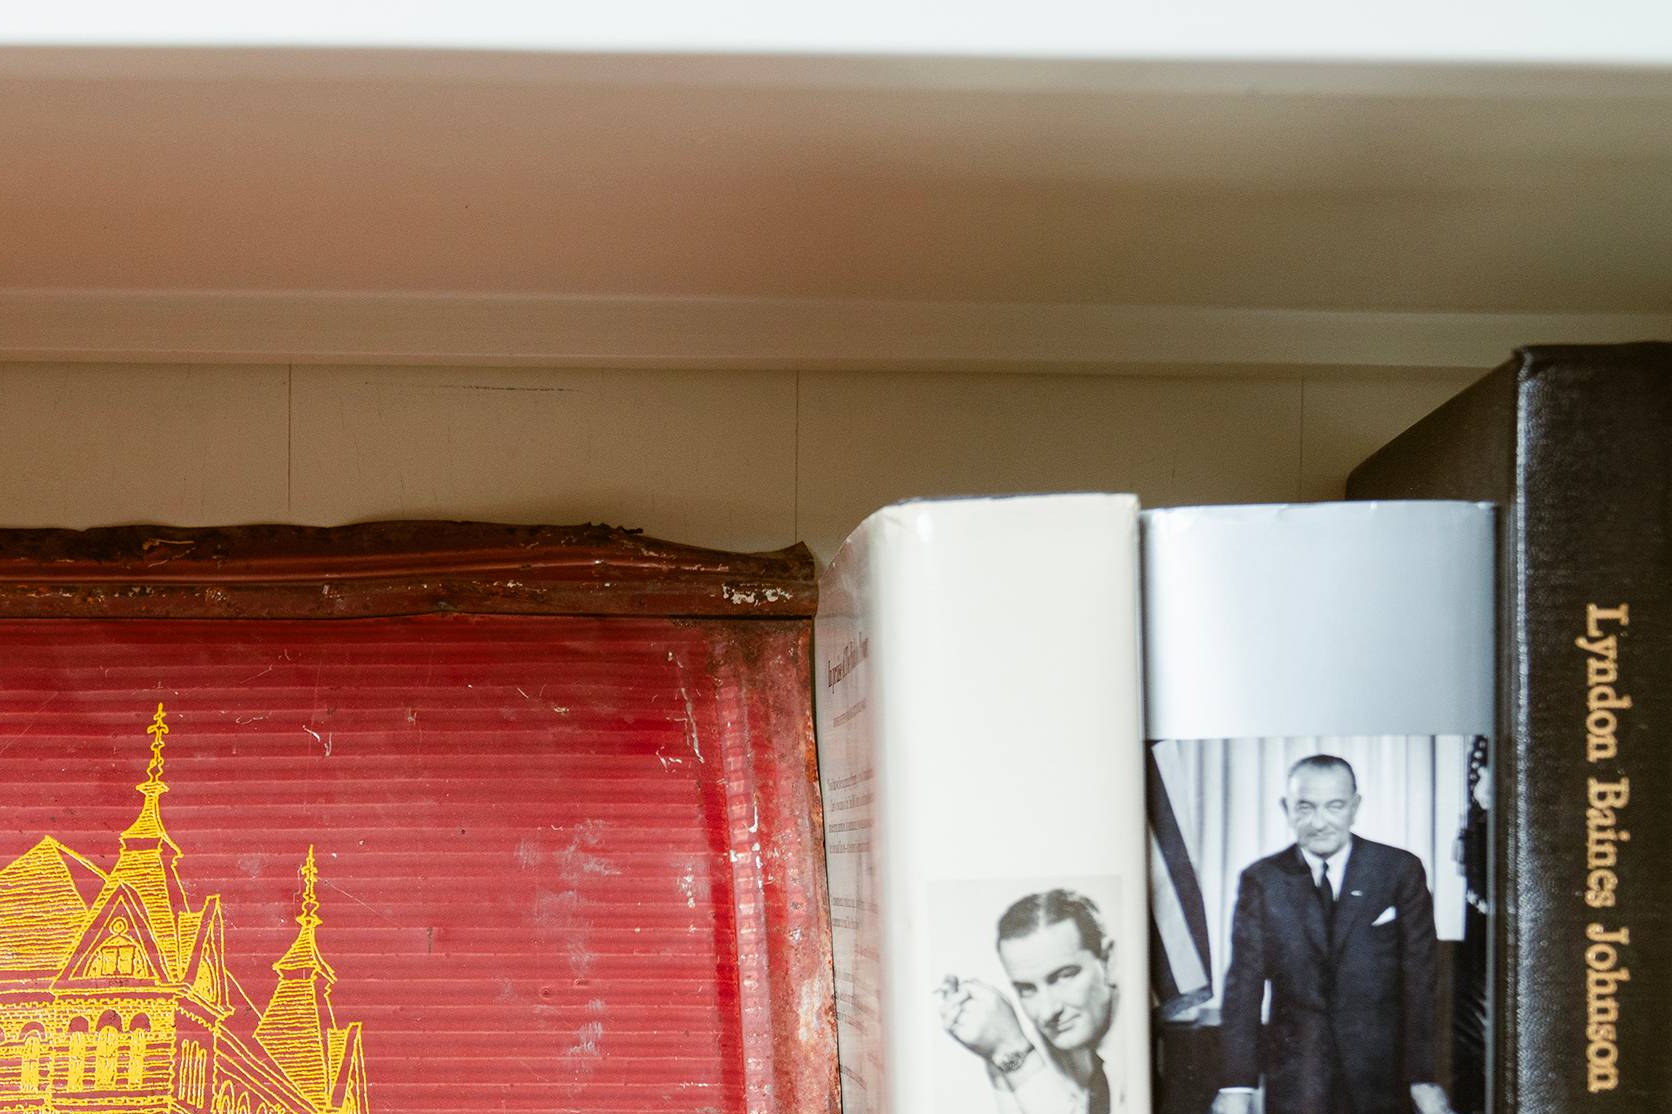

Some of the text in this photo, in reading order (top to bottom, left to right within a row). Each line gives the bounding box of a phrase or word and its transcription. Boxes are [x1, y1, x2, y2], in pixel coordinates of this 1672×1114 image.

[1575, 602, 1633, 764] Lyndon
[1584, 776, 1631, 909] Baines
[1584, 922, 1632, 1093] Johnson
